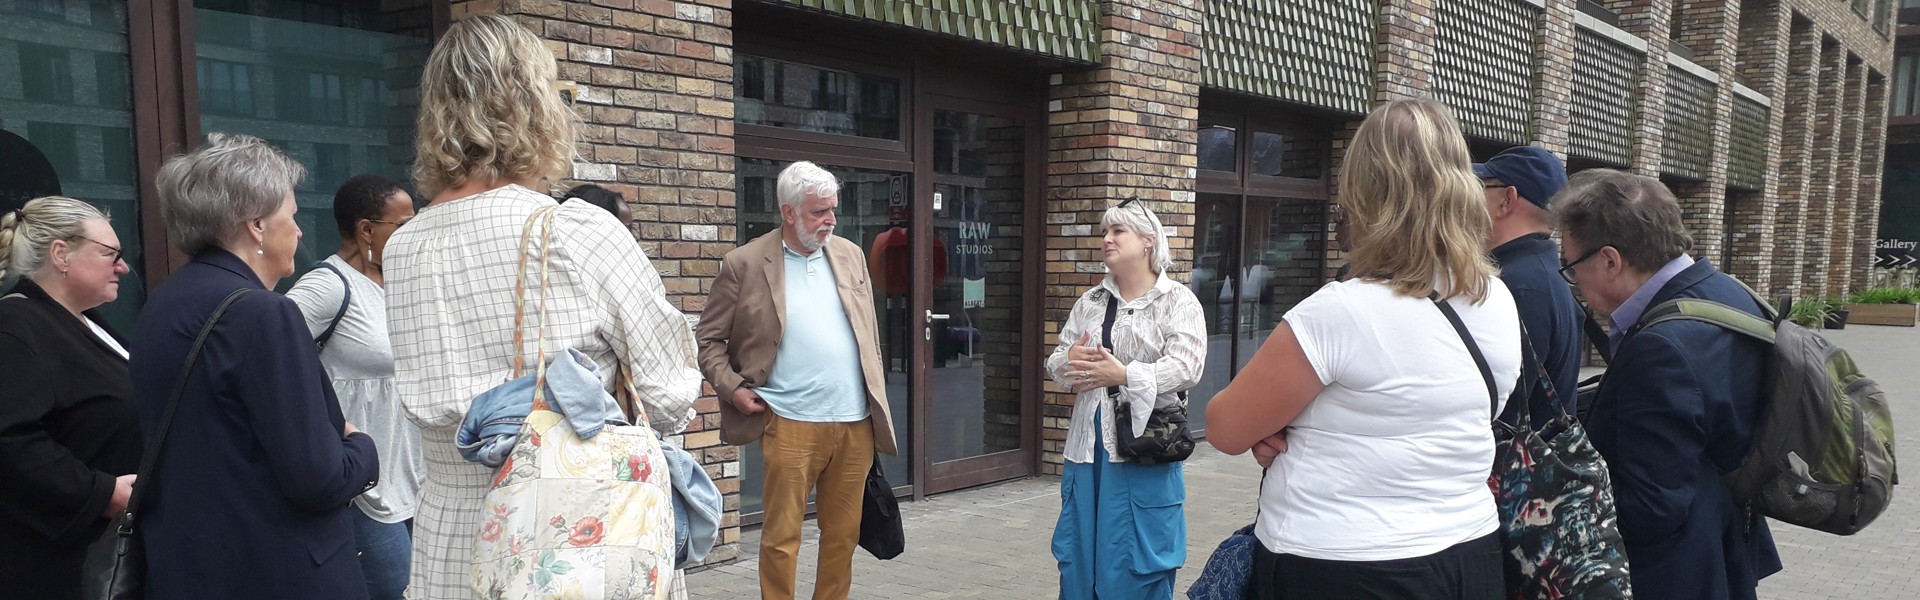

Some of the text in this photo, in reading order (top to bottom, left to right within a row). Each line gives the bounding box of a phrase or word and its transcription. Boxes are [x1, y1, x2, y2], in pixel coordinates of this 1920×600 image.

[959, 221, 991, 239] RAW
[956, 244, 993, 255] STUDIOS
[1875, 239, 1918, 251] Gallery
